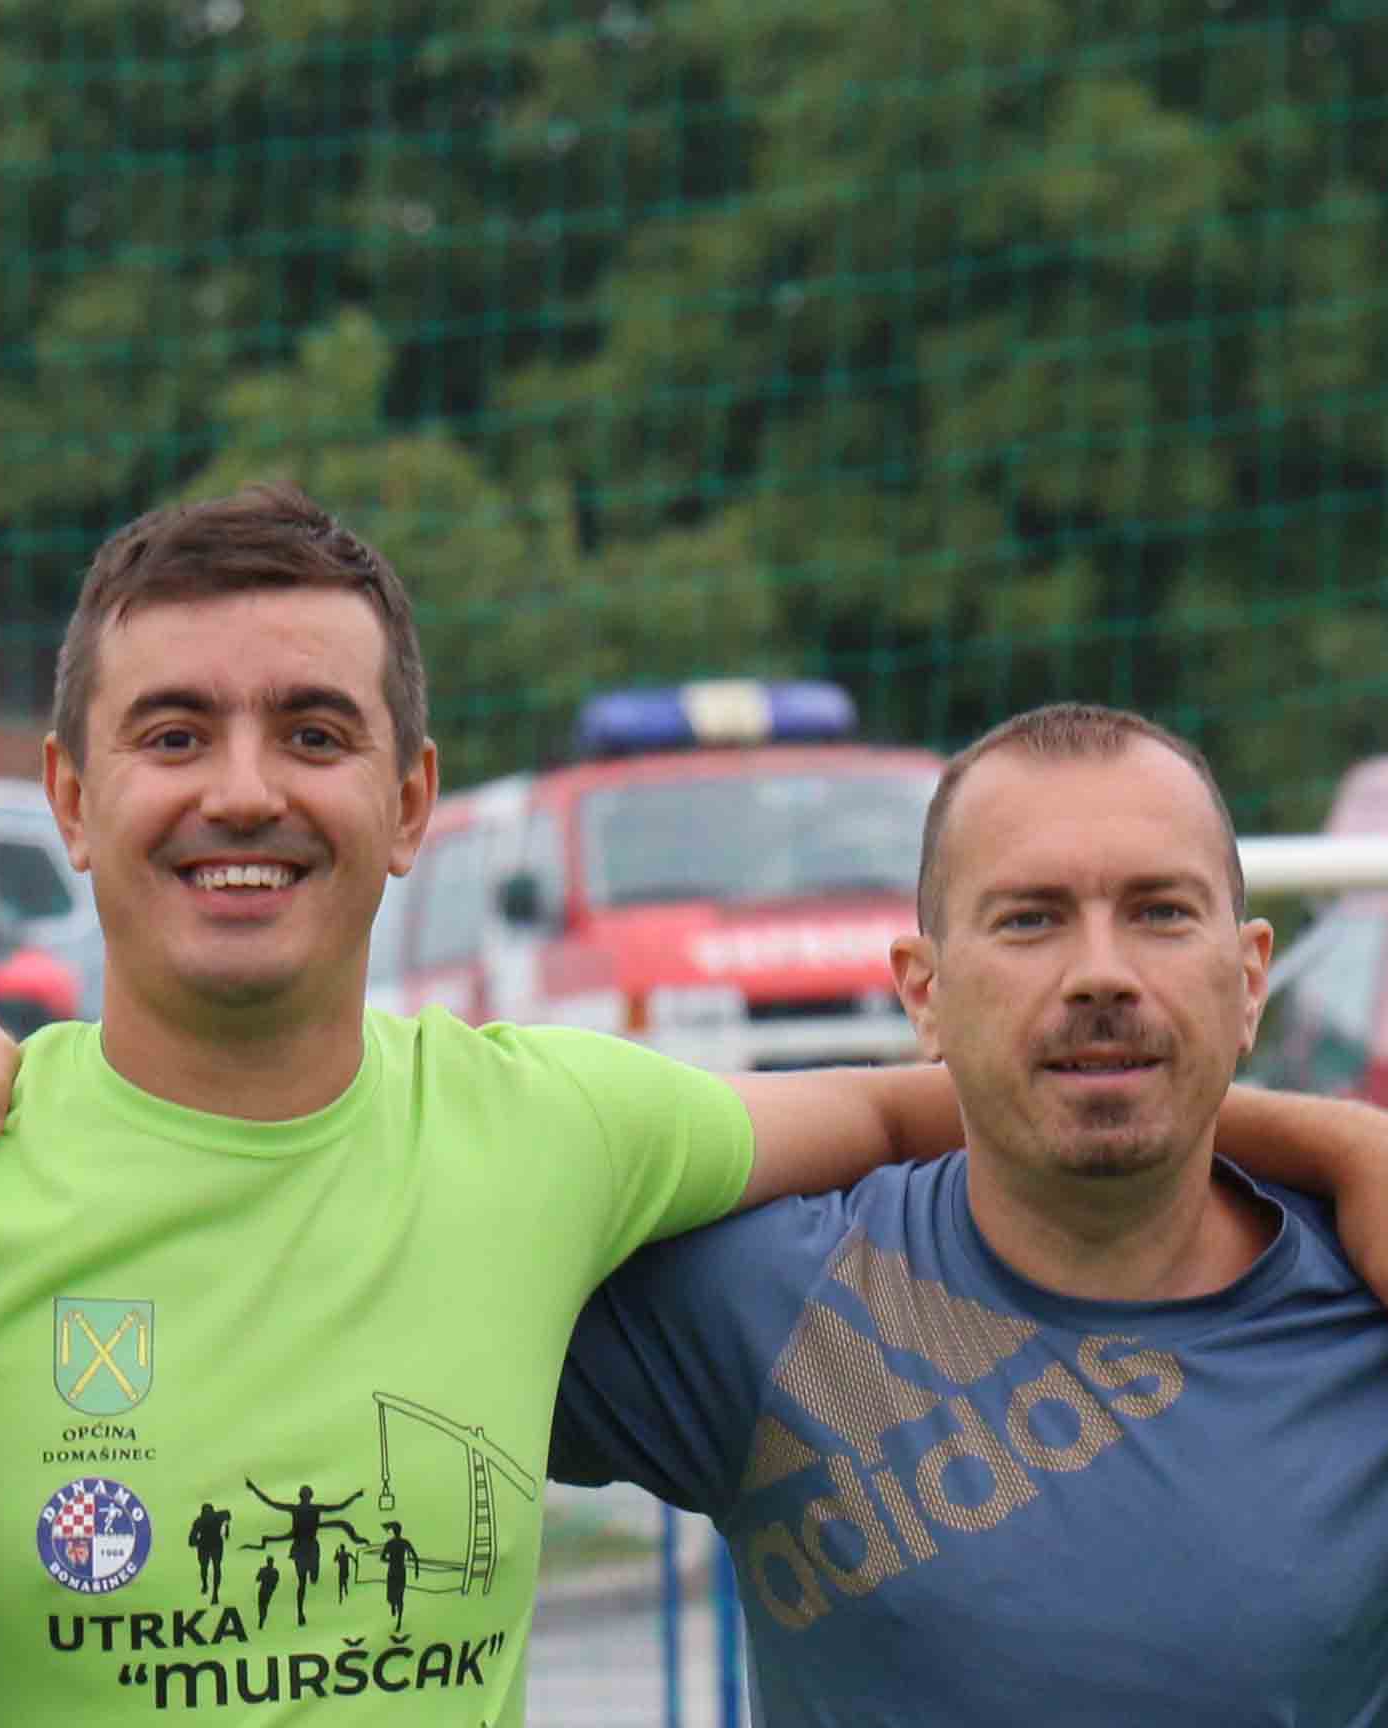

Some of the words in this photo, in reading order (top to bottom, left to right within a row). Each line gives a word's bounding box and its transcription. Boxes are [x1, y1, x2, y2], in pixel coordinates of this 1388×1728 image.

[43, 1479, 145, 1524] DINAMO
[752, 1334, 1184, 1630] adidas
[48, 1607, 248, 1652] UTRKA
